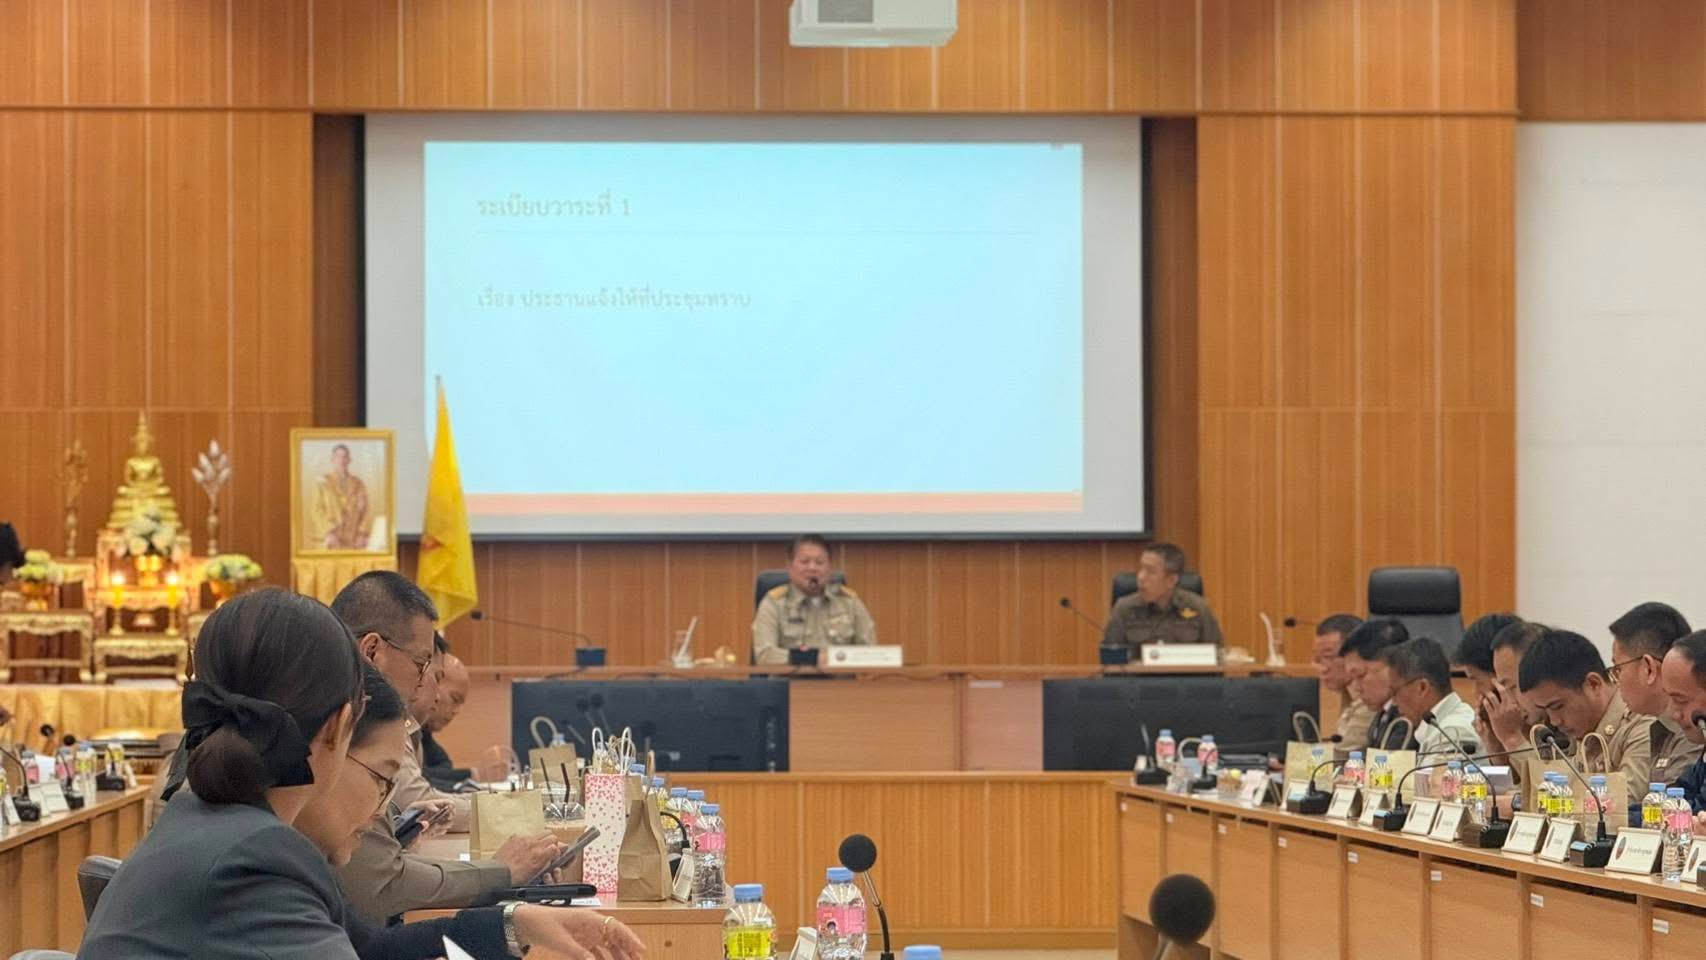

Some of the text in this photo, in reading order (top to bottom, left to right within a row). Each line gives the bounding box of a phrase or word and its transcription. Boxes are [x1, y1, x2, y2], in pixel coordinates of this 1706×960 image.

[477, 188, 632, 217] ระเบียบวาระที่ 1
[477, 285, 515, 308] เรื่อง
